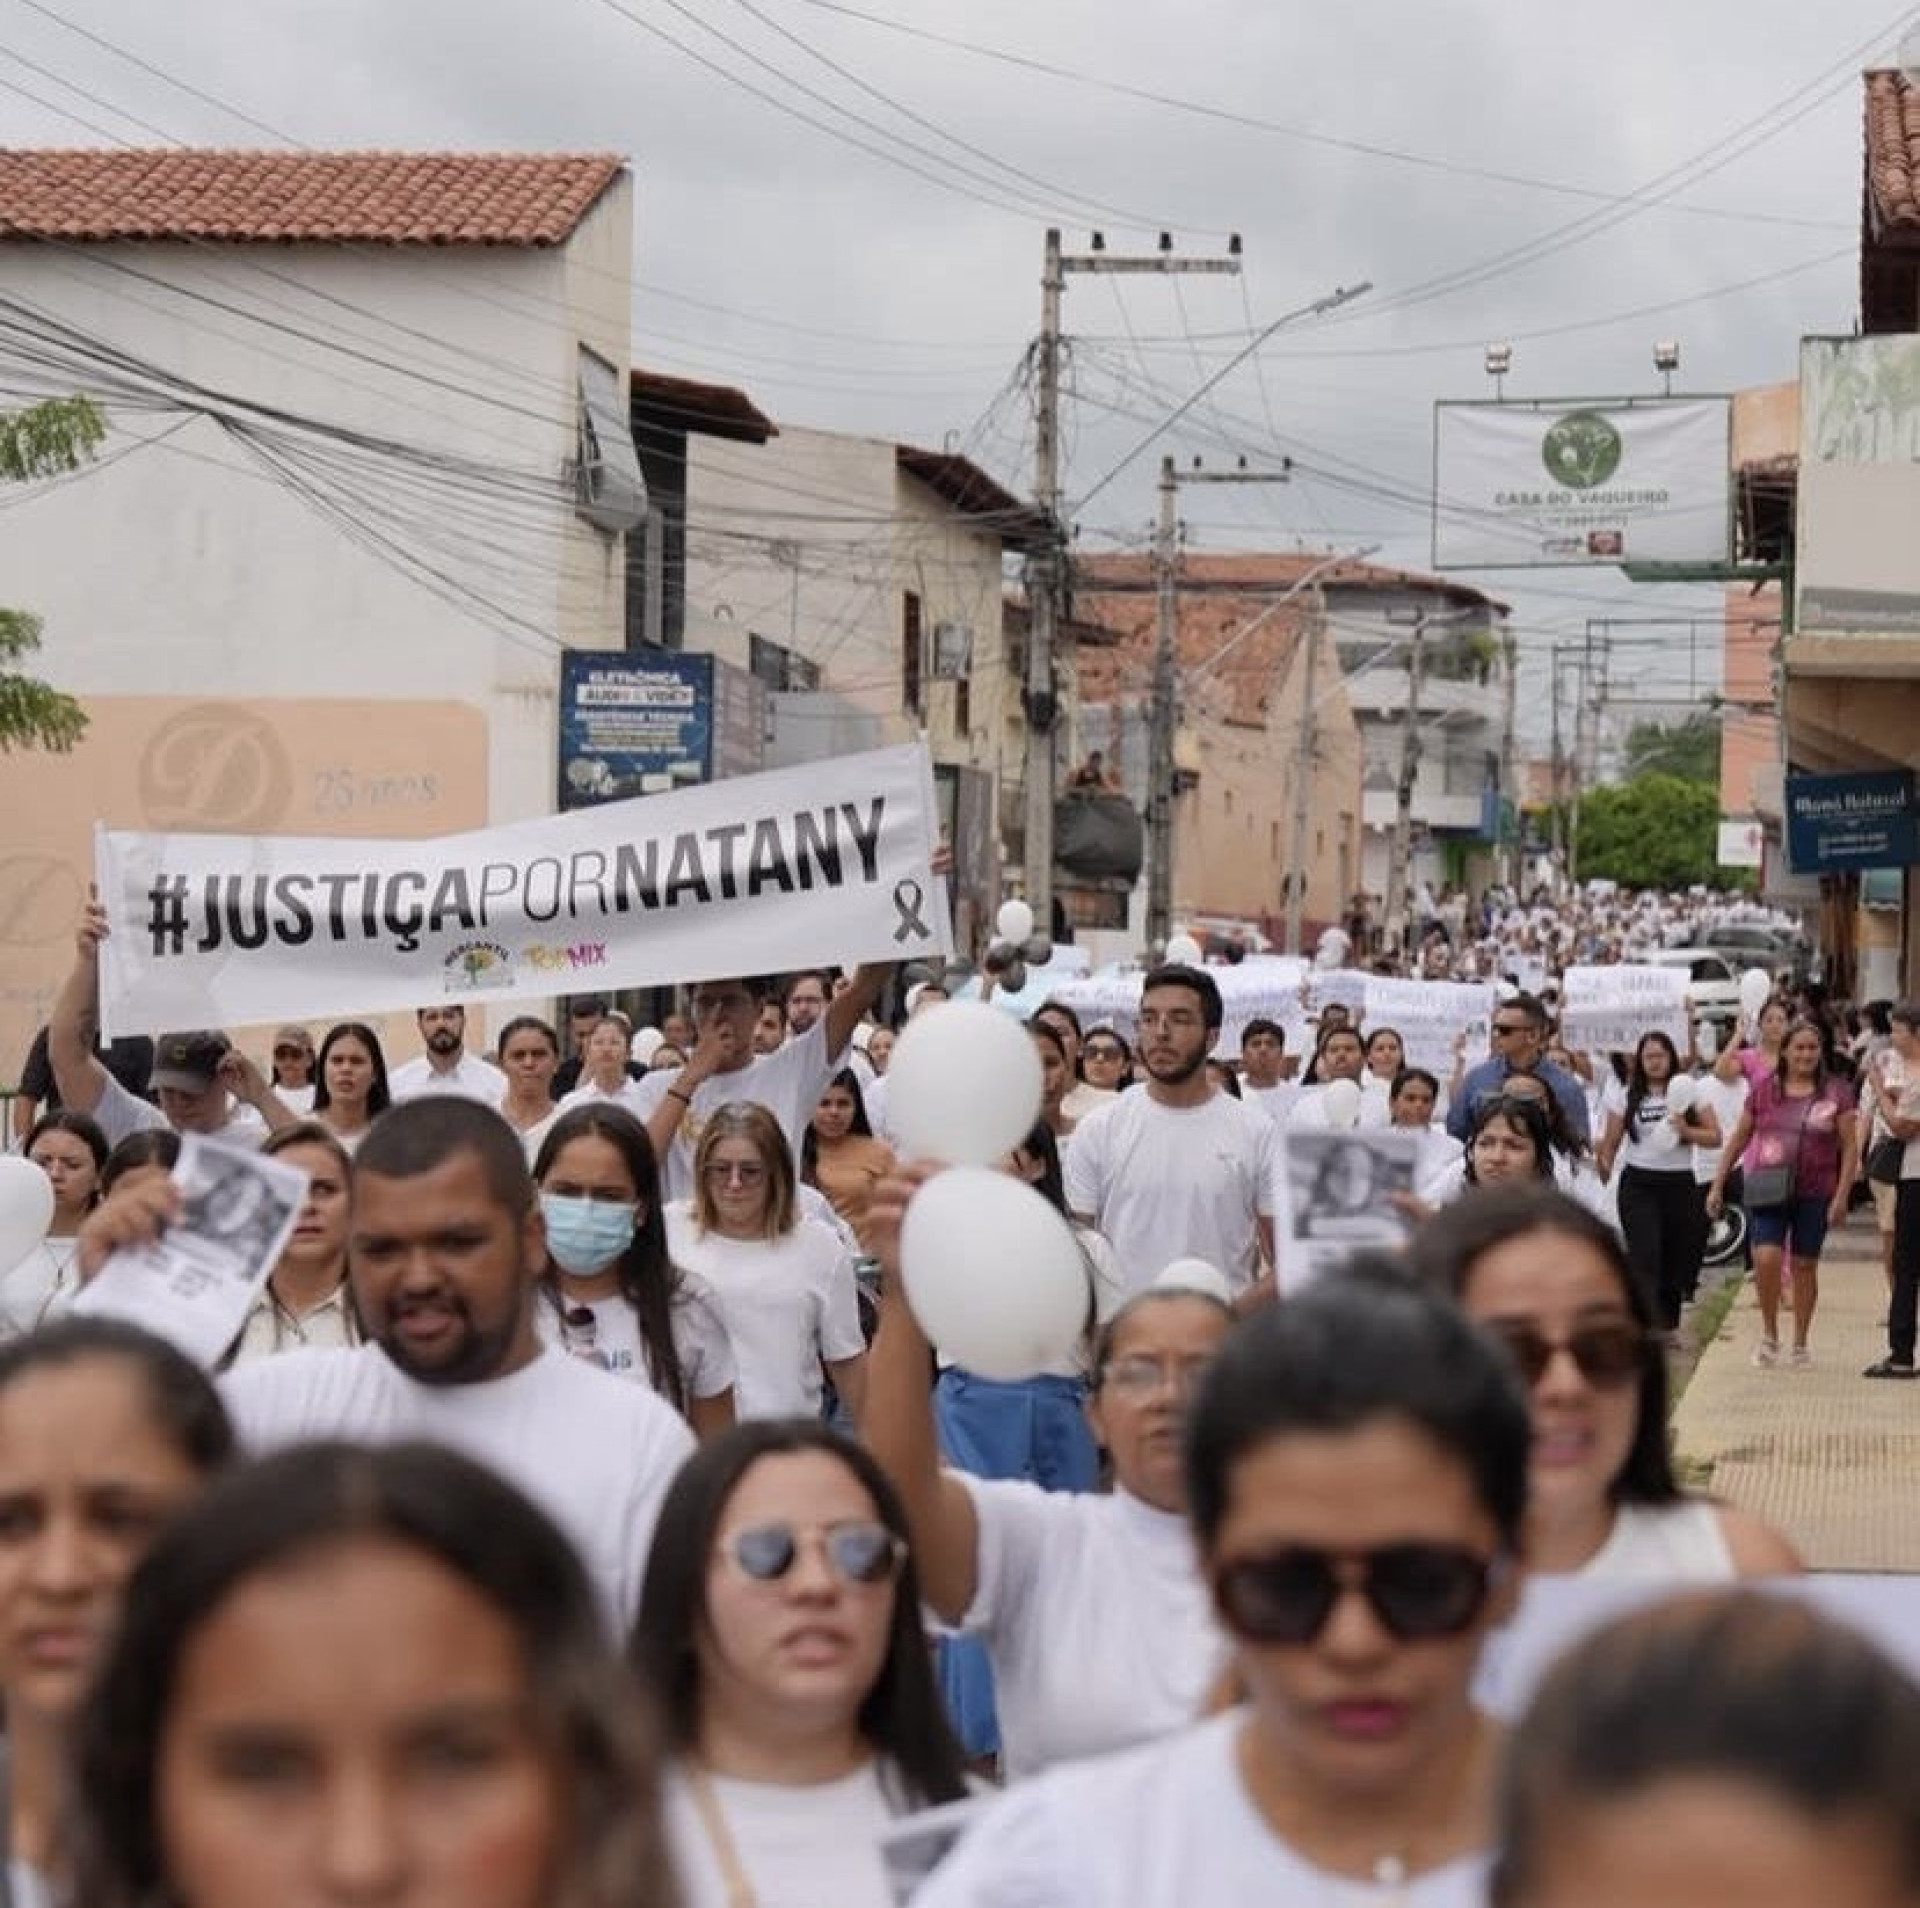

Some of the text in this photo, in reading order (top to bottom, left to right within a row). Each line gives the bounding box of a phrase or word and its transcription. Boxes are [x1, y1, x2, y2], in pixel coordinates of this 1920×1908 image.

[1495, 486, 1669, 504] CASA DO VAQUEIRO
[148, 797, 885, 956] #JUSTIÇAPORNATANY
